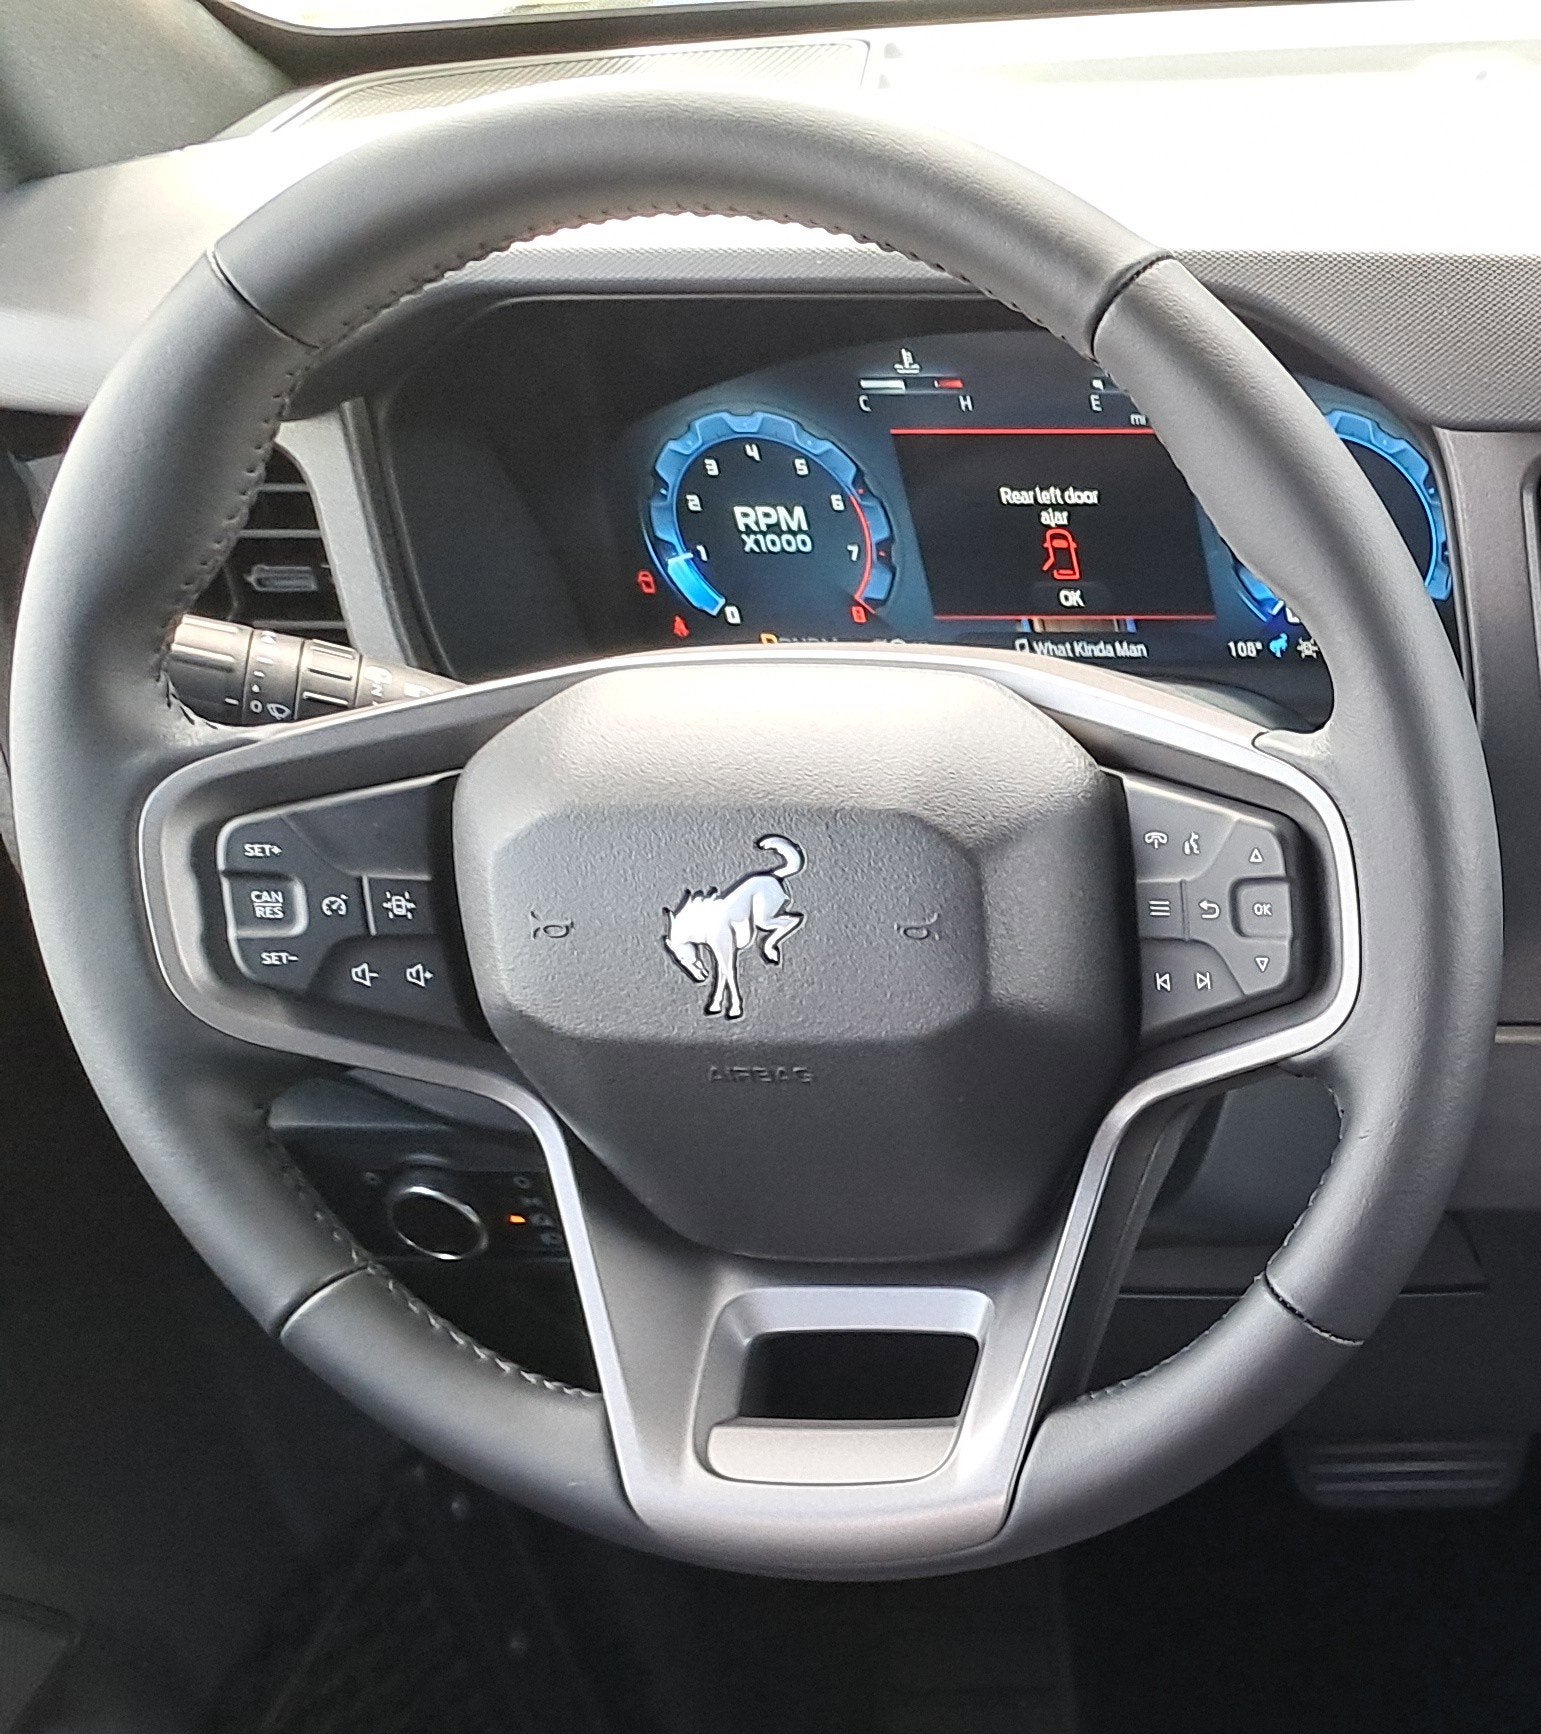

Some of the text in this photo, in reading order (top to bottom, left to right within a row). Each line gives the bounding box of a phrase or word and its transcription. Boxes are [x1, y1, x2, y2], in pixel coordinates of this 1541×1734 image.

[858, 394, 872, 413] C
[958, 394, 973, 413] H
[1089, 394, 1103, 413] E
[744, 443, 761, 462] 4
[703, 457, 720, 476] 3
[794, 457, 810, 476] 5
[685, 493, 702, 512] 2
[830, 493, 846, 512] 6
[999, 486, 1099, 506] Rear left door
[732, 505, 809, 533] RPM
[1040, 508, 1069, 528] ajar
[696, 543, 709, 562] 1
[741, 533, 813, 553] X1000
[847, 543, 859, 562] 7
[1058, 588, 1085, 608] OK
[724, 605, 742, 625] 0
[1032, 640, 1149, 659] What Kinda Man
[243, 843, 283, 857] SET+
[250, 890, 284, 904] CAN
[254, 905, 285, 919] RES
[1253, 903, 1274, 916] OK
